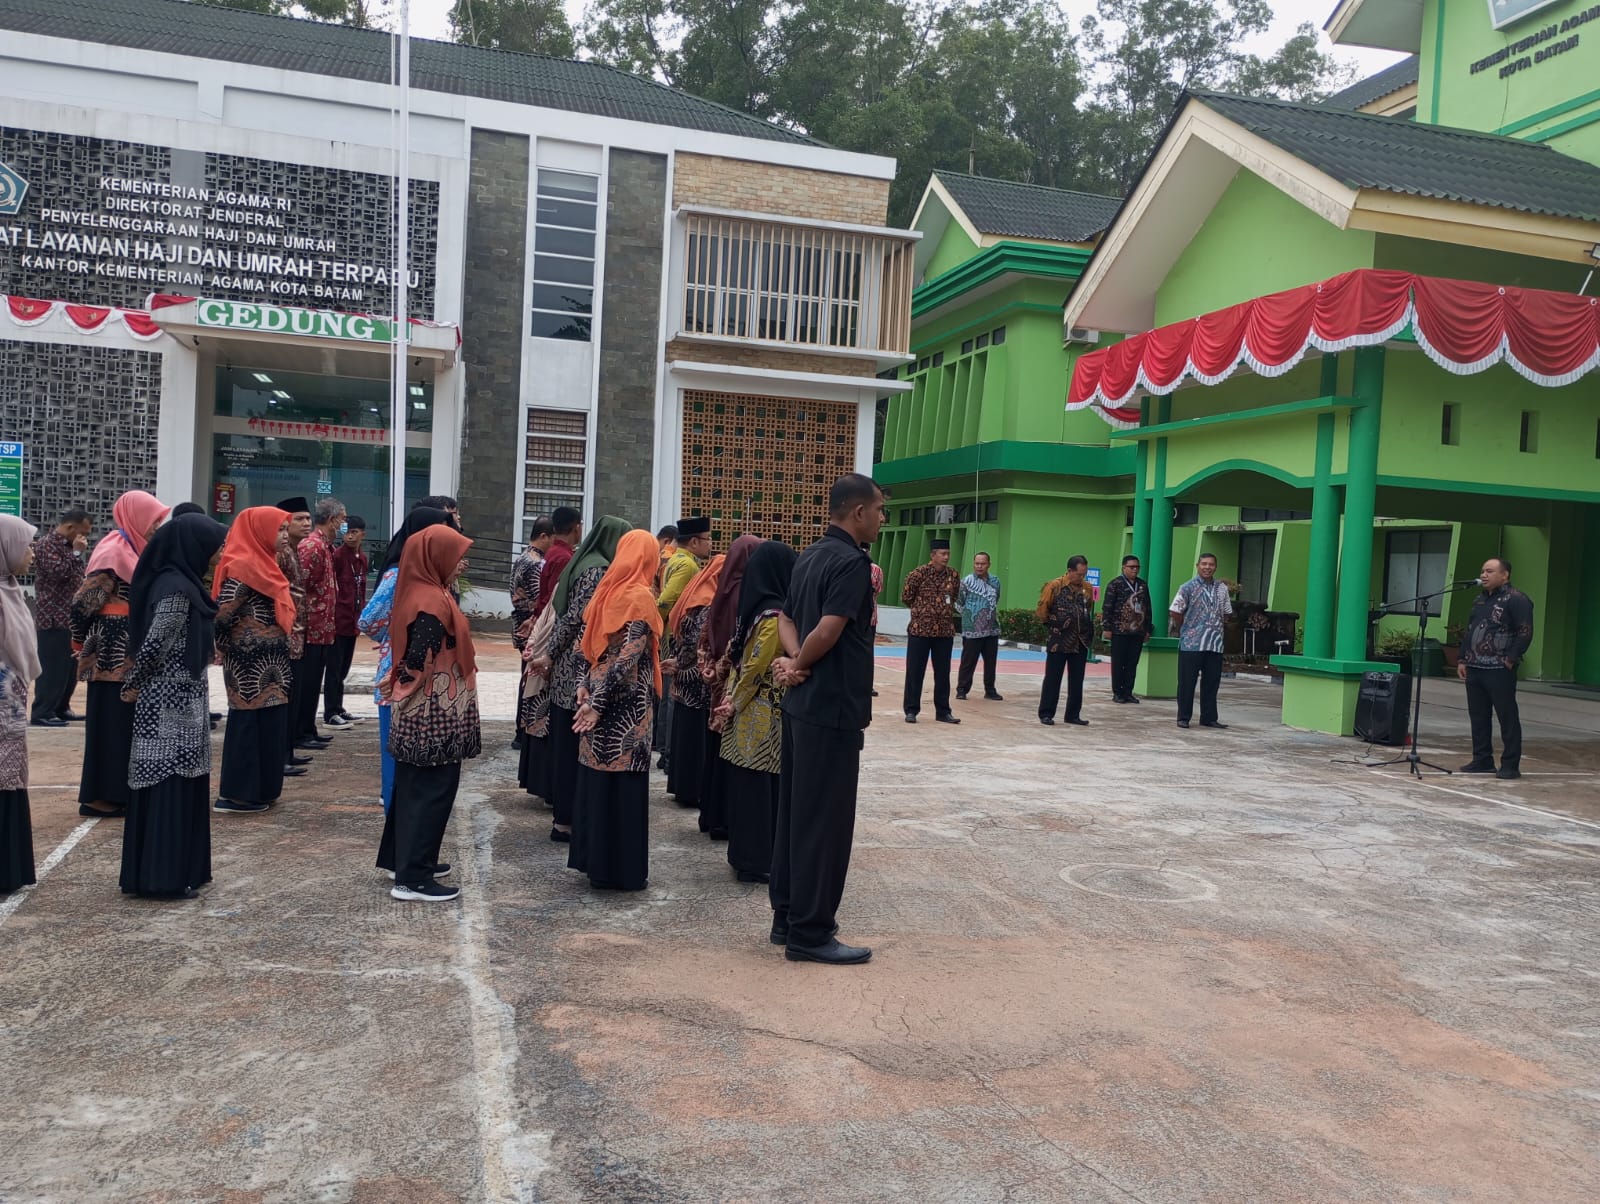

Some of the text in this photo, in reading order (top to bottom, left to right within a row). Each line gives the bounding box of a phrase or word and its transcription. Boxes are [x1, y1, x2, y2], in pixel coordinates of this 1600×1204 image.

[1469, 24, 1558, 75] KEMENTERIAN
[1498, 33, 1580, 80] KOTA BATAM
[100, 176, 291, 211] KEMENTERIAN AGAMA RI
[106, 196, 284, 228] DIREKTORAT JENDERAL
[41, 208, 336, 252] PENYELENGGARAAN HAJI DAN UMRAH
[26, 229, 129, 258] LAYANAN
[134, 240, 183, 263] HAJI
[187, 246, 231, 269] DAN
[237, 252, 312, 278] UMRAH
[21, 254, 363, 301] KANTOR KEMENTERIAN AGAMA KOTA BATAM
[198, 300, 375, 339] GEDUNG
